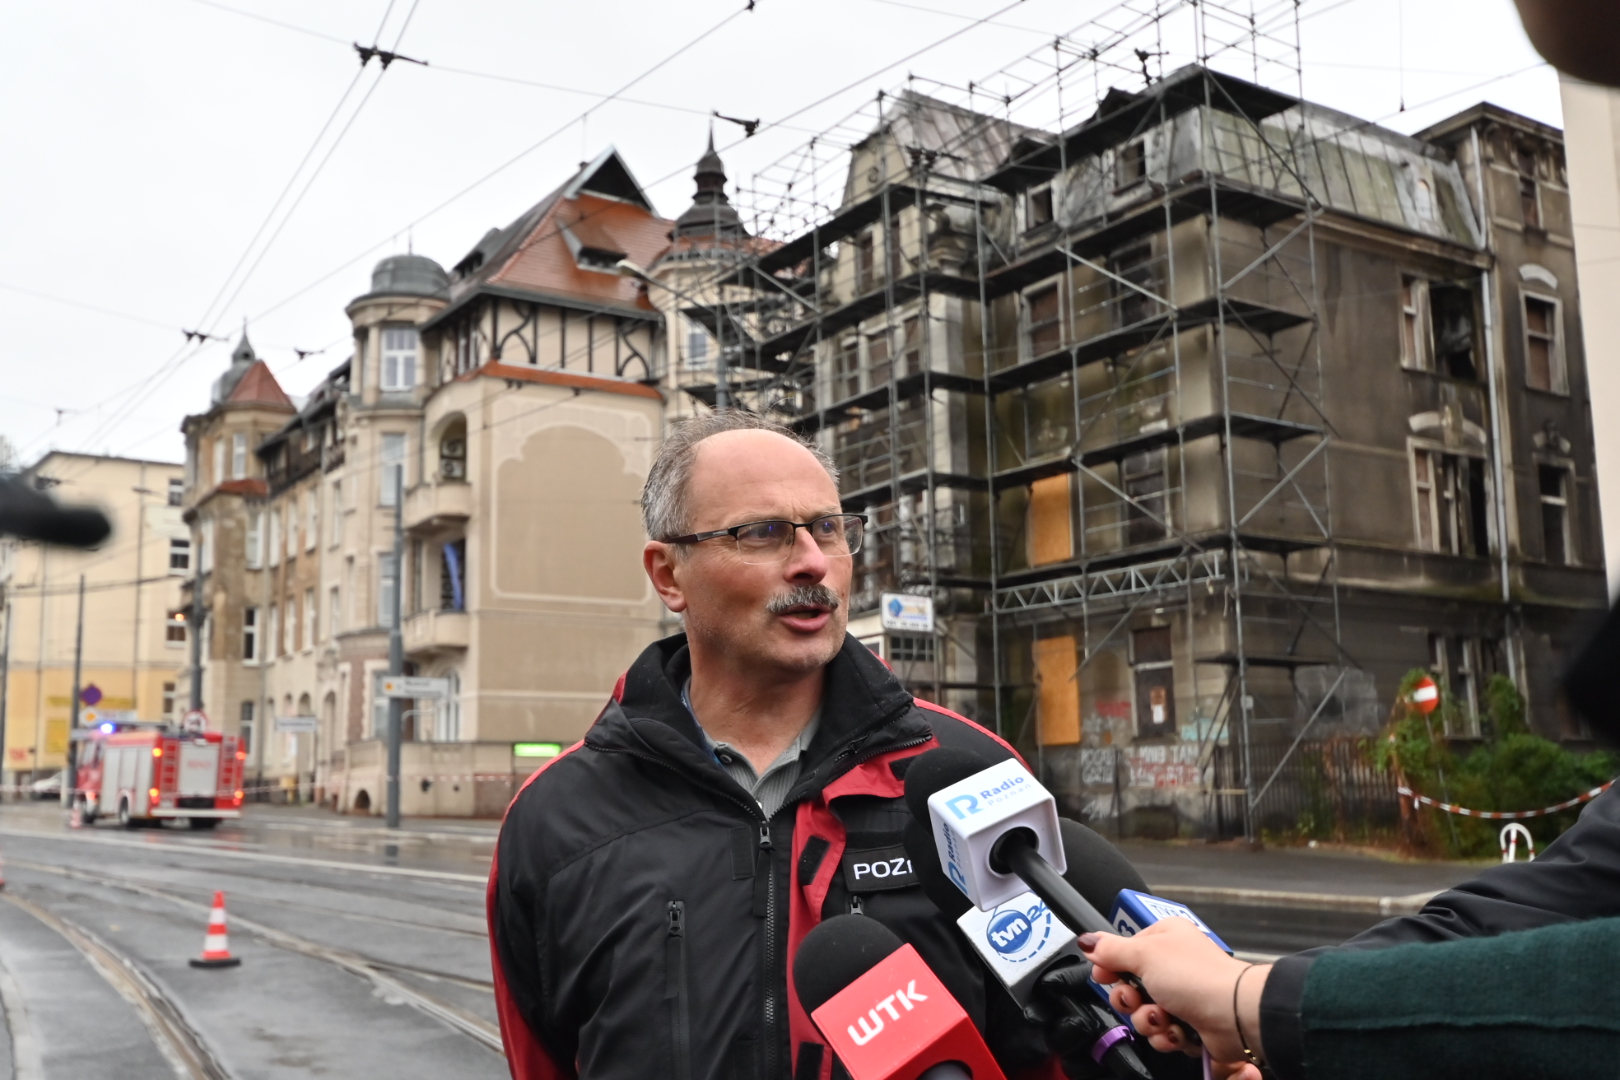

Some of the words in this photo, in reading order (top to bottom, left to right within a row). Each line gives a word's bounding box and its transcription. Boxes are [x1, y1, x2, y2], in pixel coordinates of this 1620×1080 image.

[979, 776, 1025, 800] Radio
[942, 822, 957, 863] Radio
[990, 917, 1029, 948] tvn
[847, 978, 929, 1047] WTK
